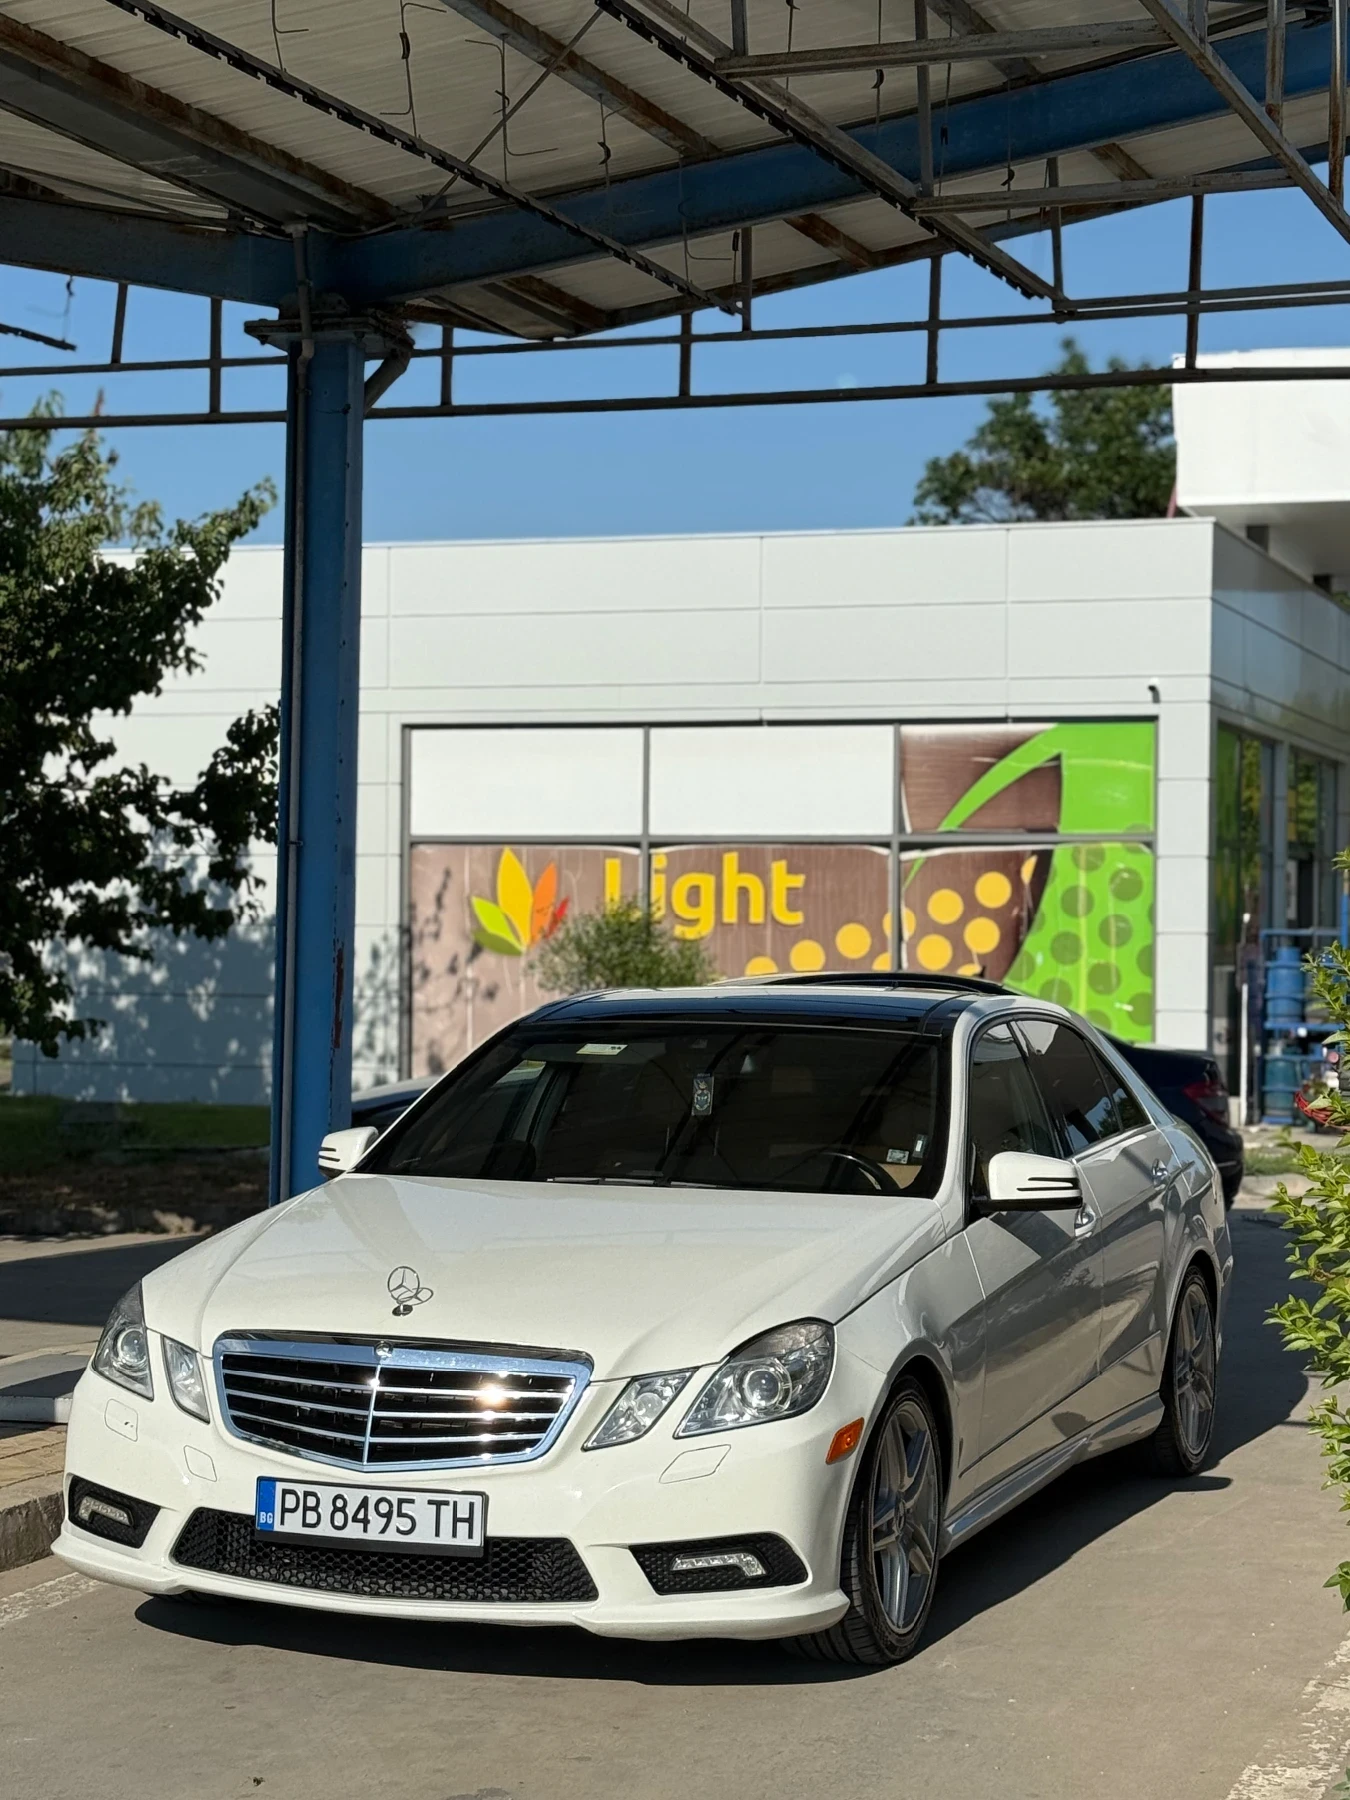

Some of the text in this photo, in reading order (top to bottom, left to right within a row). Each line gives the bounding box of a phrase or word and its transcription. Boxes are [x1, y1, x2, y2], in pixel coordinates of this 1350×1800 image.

[259, 1511, 274, 1524] BG
[280, 1488, 475, 1540] PB 8495 TH
